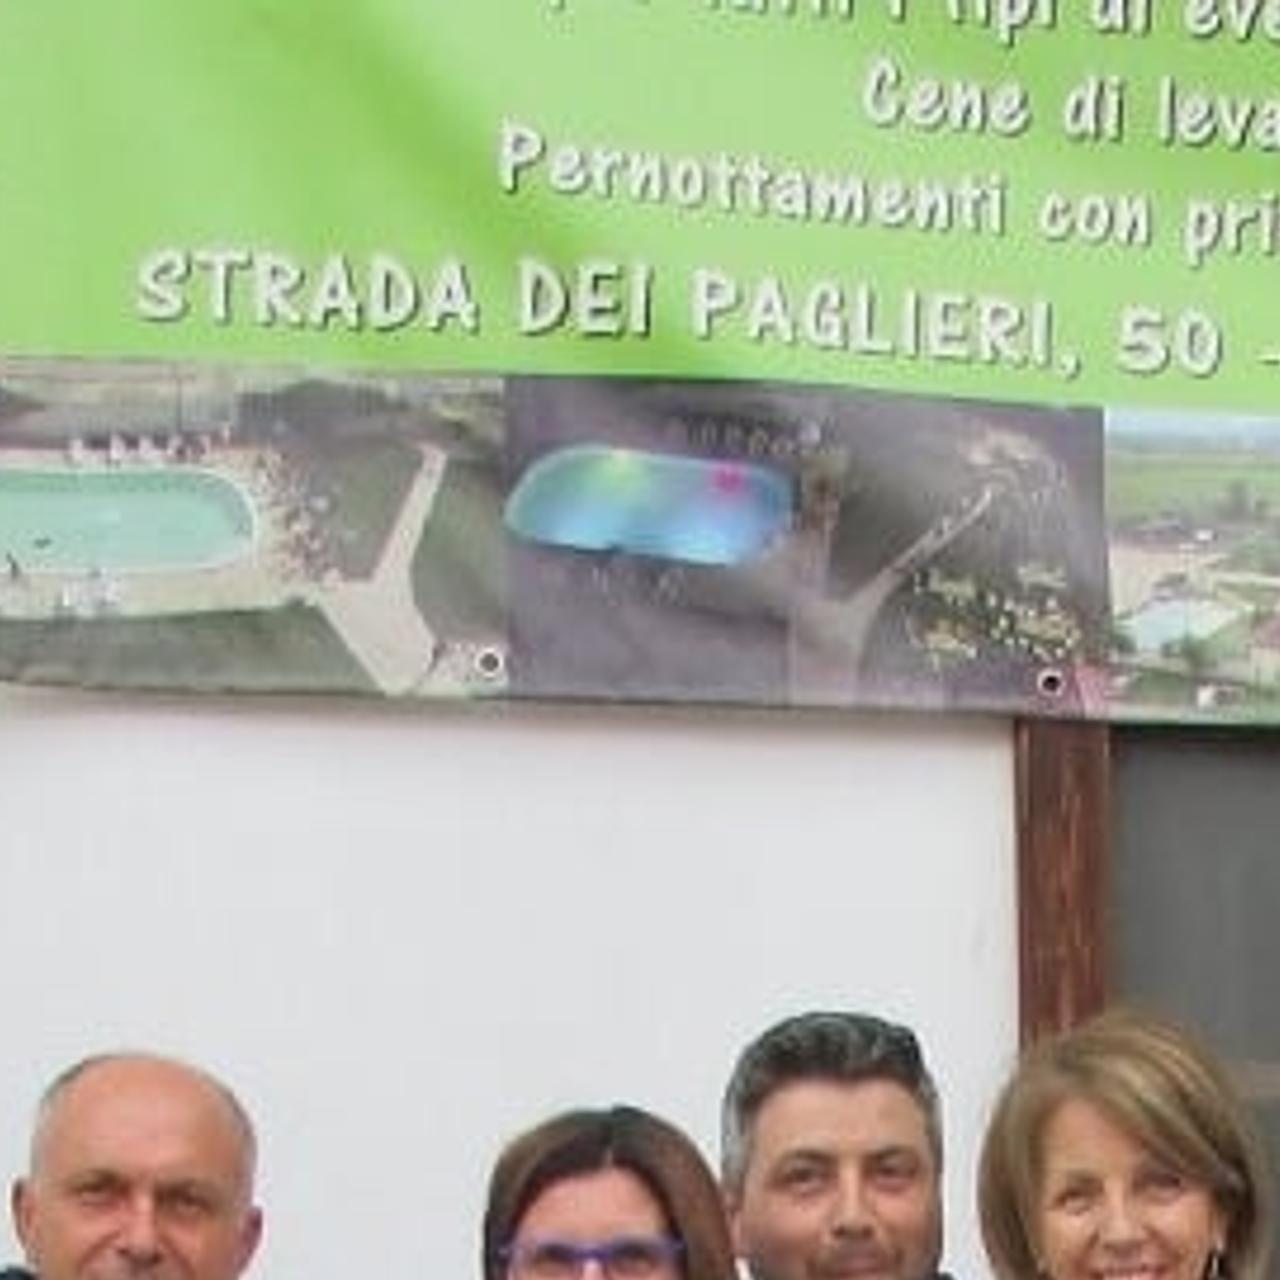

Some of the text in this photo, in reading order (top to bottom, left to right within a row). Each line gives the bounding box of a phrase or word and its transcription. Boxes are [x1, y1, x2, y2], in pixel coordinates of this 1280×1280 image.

[863, 56, 1032, 135] Cene
[1064, 74, 1124, 140] di
[499, 118, 1008, 234] Pernottamenti
[1039, 190, 1154, 246] con
[138, 250, 482, 334] STRADA
[520, 256, 655, 338] DEI
[693, 266, 1085, 380] PAGLIERI,
[1118, 304, 1225, 380] 50
